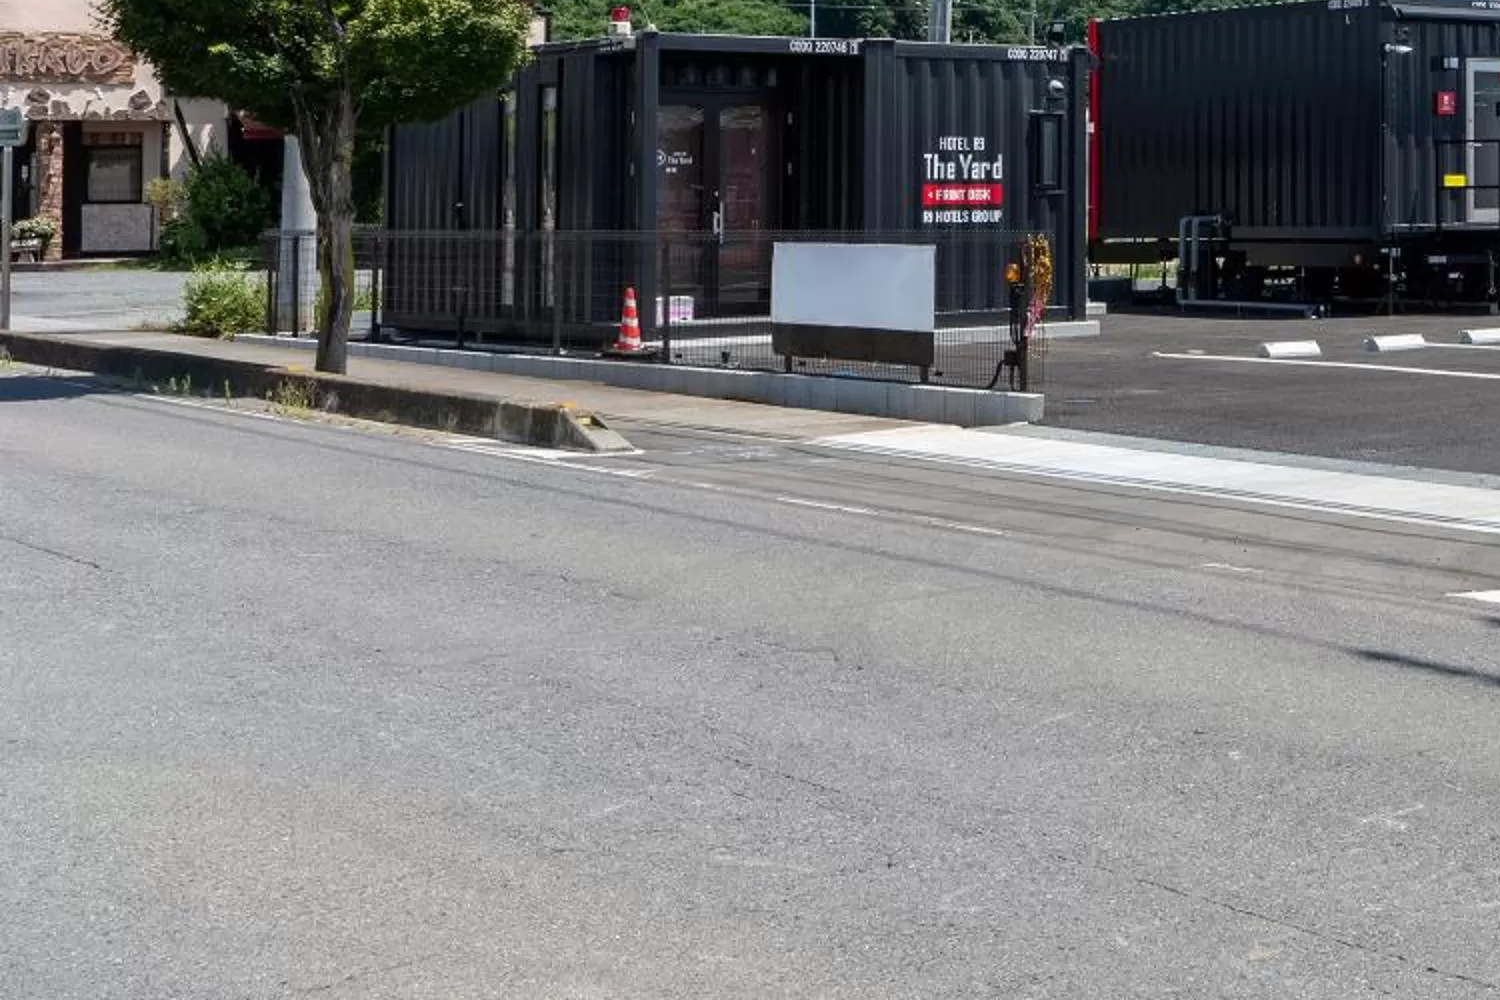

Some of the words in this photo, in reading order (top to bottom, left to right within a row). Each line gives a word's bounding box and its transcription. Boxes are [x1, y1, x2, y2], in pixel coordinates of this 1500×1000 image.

[939, 136, 970, 151] HOTEL
[923, 153, 956, 179] The
[959, 153, 1003, 179] Yard
[935, 210, 969, 223] HOTELS
[971, 210, 1002, 222] GROUP
